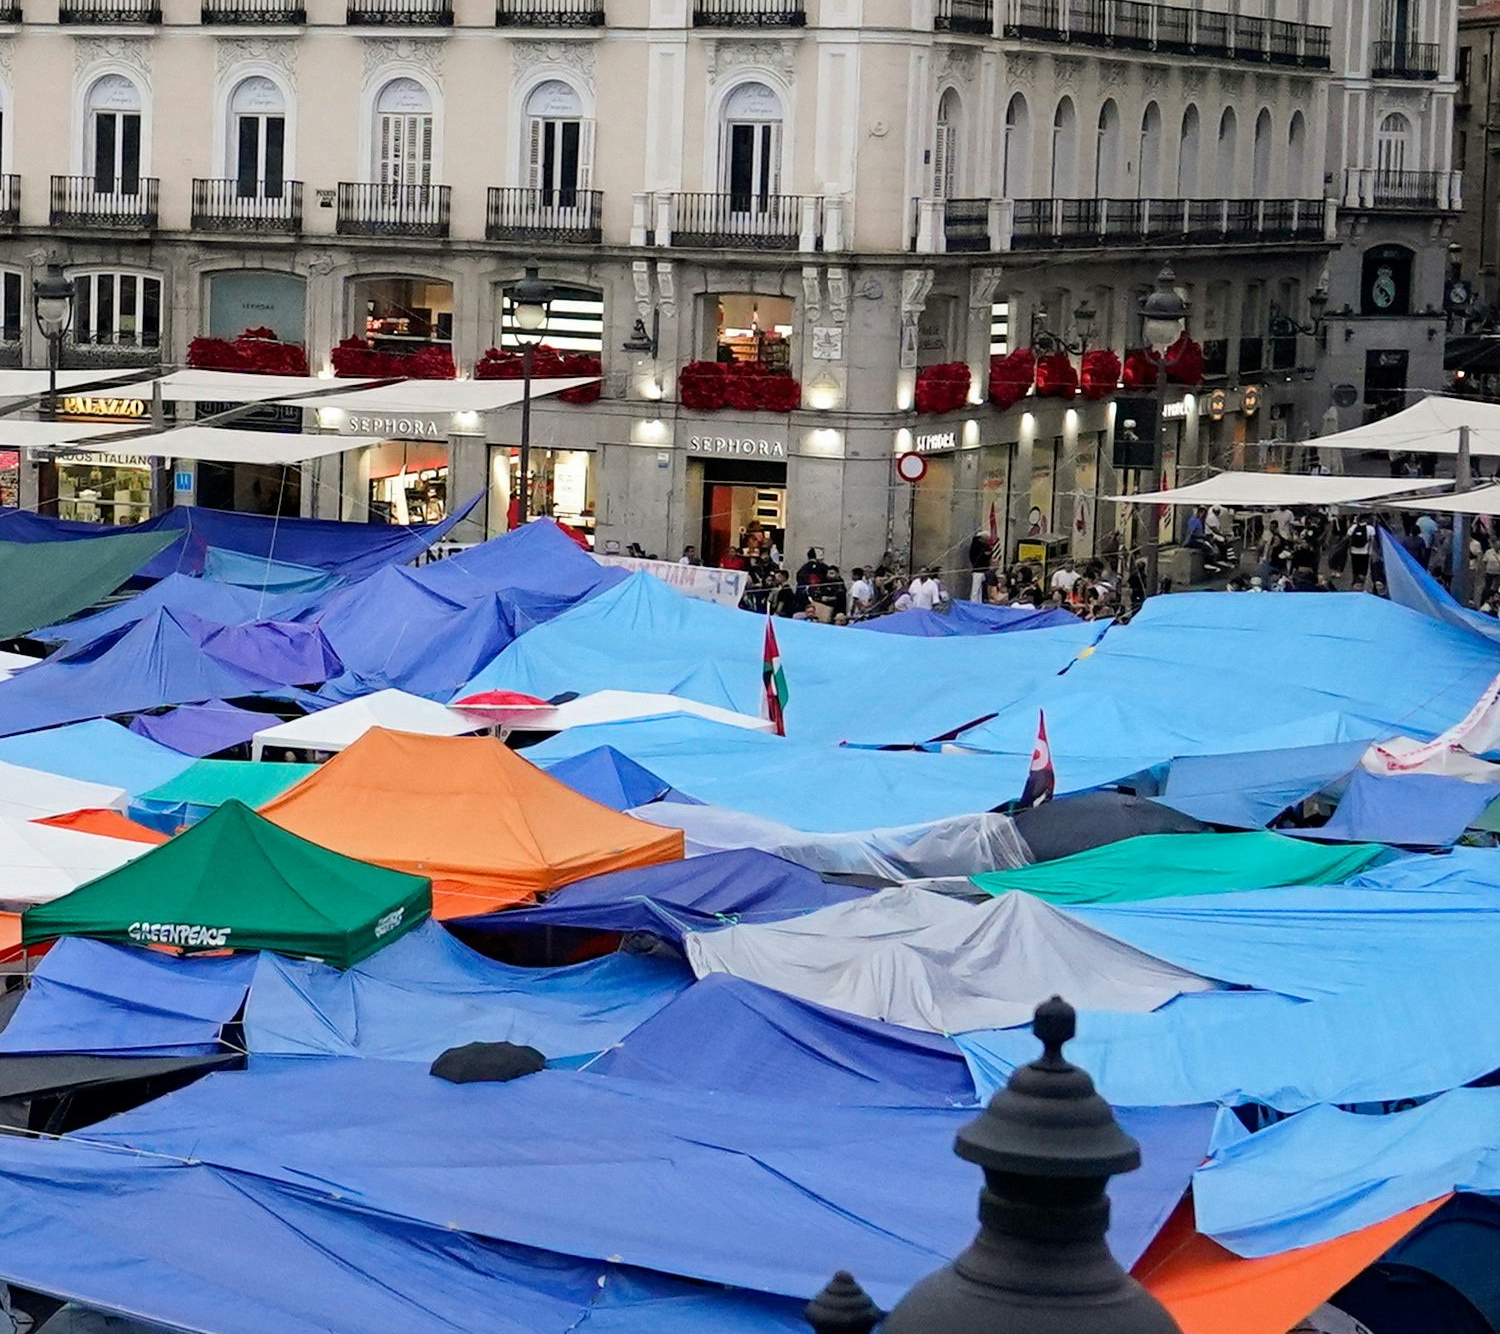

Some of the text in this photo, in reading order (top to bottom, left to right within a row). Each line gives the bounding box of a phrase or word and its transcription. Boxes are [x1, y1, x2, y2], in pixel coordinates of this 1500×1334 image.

[350, 417, 439, 436] SEPHORA
[690, 435, 784, 457] SEPHORA
[127, 922, 232, 946] GREENPEACE
